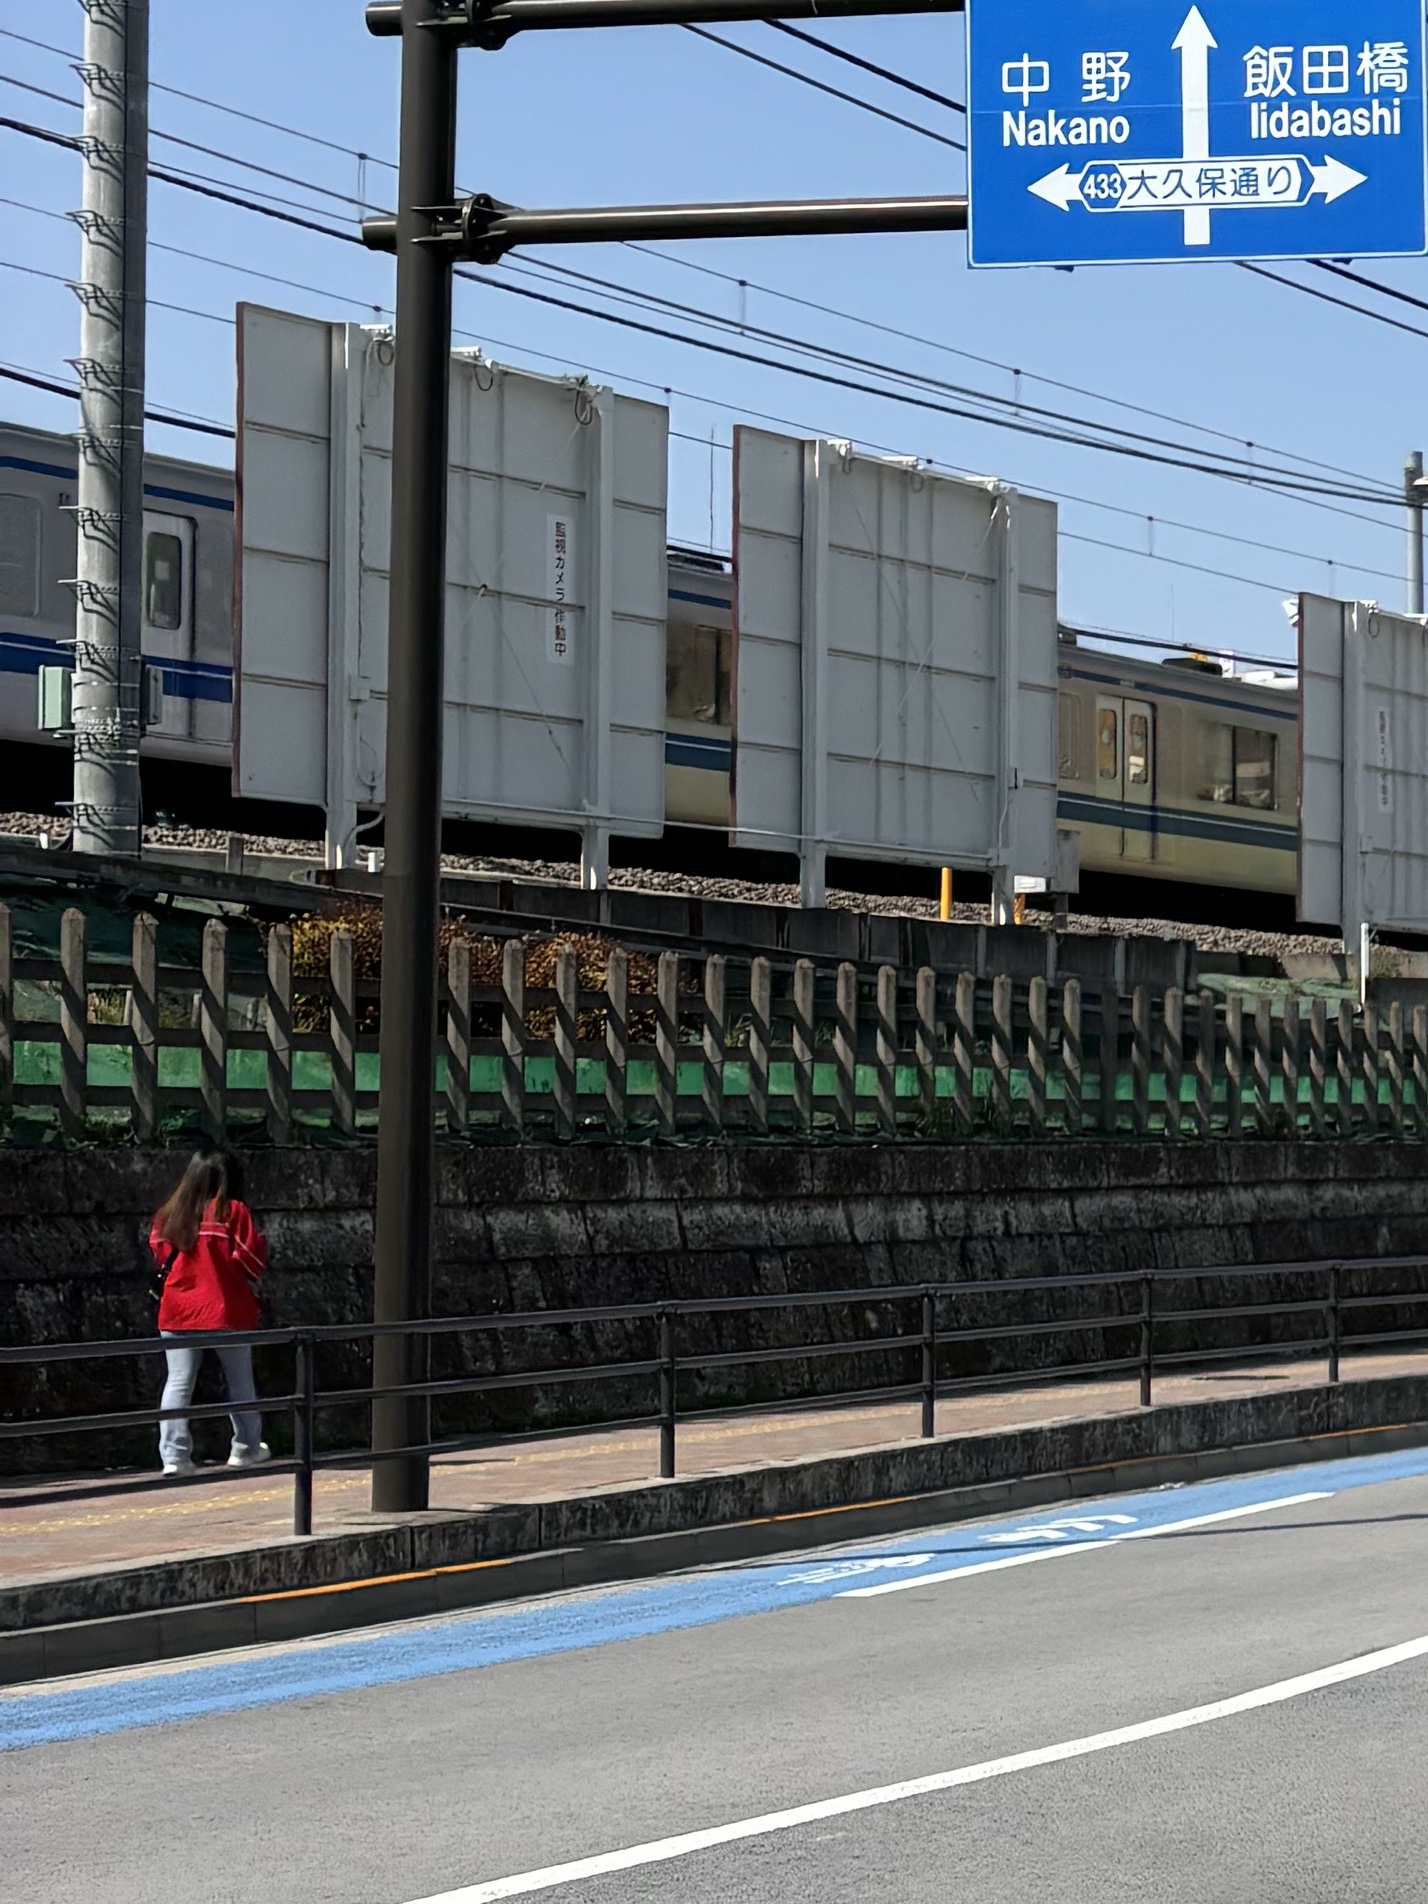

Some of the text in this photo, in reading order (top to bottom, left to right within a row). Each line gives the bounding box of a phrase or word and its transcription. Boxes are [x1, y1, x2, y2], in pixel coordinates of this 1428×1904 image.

[1001, 50, 1131, 107] 中野
[1242, 41, 1409, 99] 飯田橋
[1002, 110, 1131, 148] Nakano
[1250, 98, 1402, 140] Iidabashi
[1082, 164, 1293, 200] 433 大久保通り
